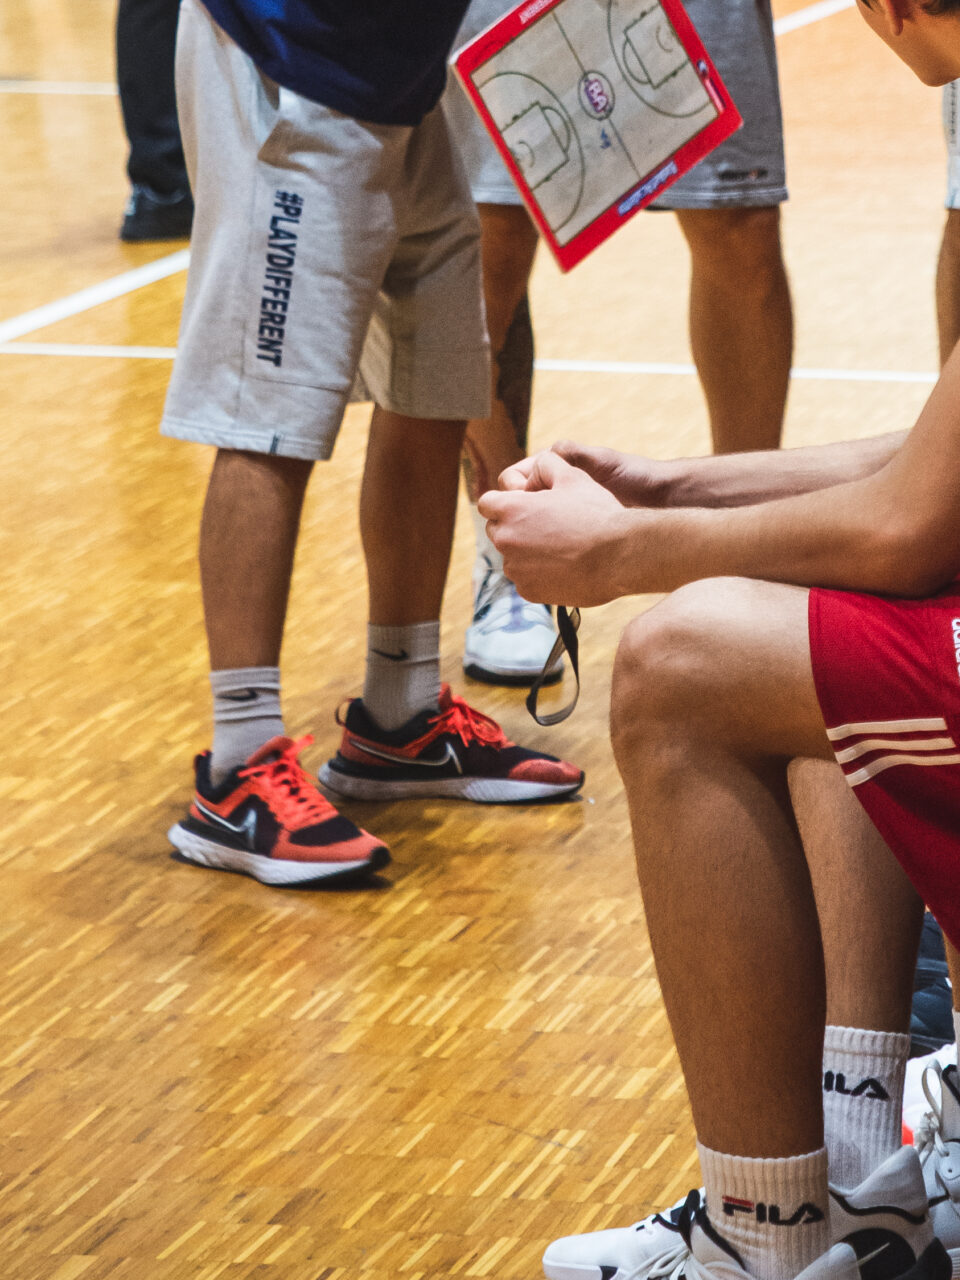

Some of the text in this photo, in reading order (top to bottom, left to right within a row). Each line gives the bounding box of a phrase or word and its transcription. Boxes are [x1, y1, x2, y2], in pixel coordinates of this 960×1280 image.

[255, 188, 305, 368] #PLAYDIFFERENT
[823, 1070, 889, 1101] ILA
[722, 1195, 825, 1226] FILA
